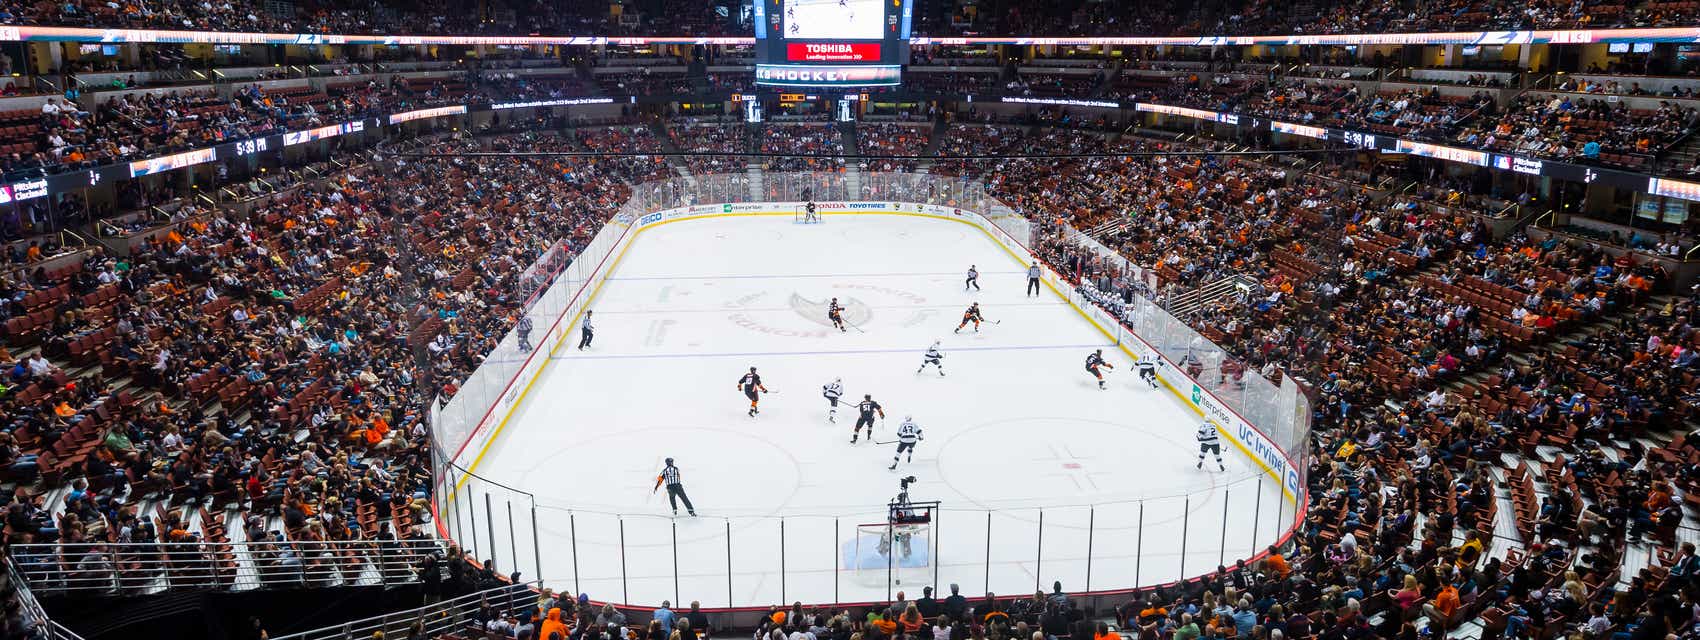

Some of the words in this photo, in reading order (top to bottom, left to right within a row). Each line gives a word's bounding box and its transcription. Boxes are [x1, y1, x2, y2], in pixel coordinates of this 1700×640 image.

[806, 44, 852, 53] TOSHIBA
[777, 71, 850, 81] HOCKEY
[1344, 131, 1362, 145] 5:39
[1364, 134, 1375, 148] PM
[236, 140, 255, 156] 5:39
[256, 137, 267, 152] PM
[1513, 157, 1543, 168] Pittsburgh
[1513, 164, 1541, 175] Cincinnati
[13, 178, 48, 192] Pittsburgh
[14, 189, 48, 201] Cincinnati
[641, 212, 662, 225] GEICO
[902, 425, 914, 434] 43
[1210, 427, 1216, 436] 2
[1238, 423, 1253, 447] UC
[1255, 437, 1283, 472] Irvine
[1243, 575, 1255, 587] 15
